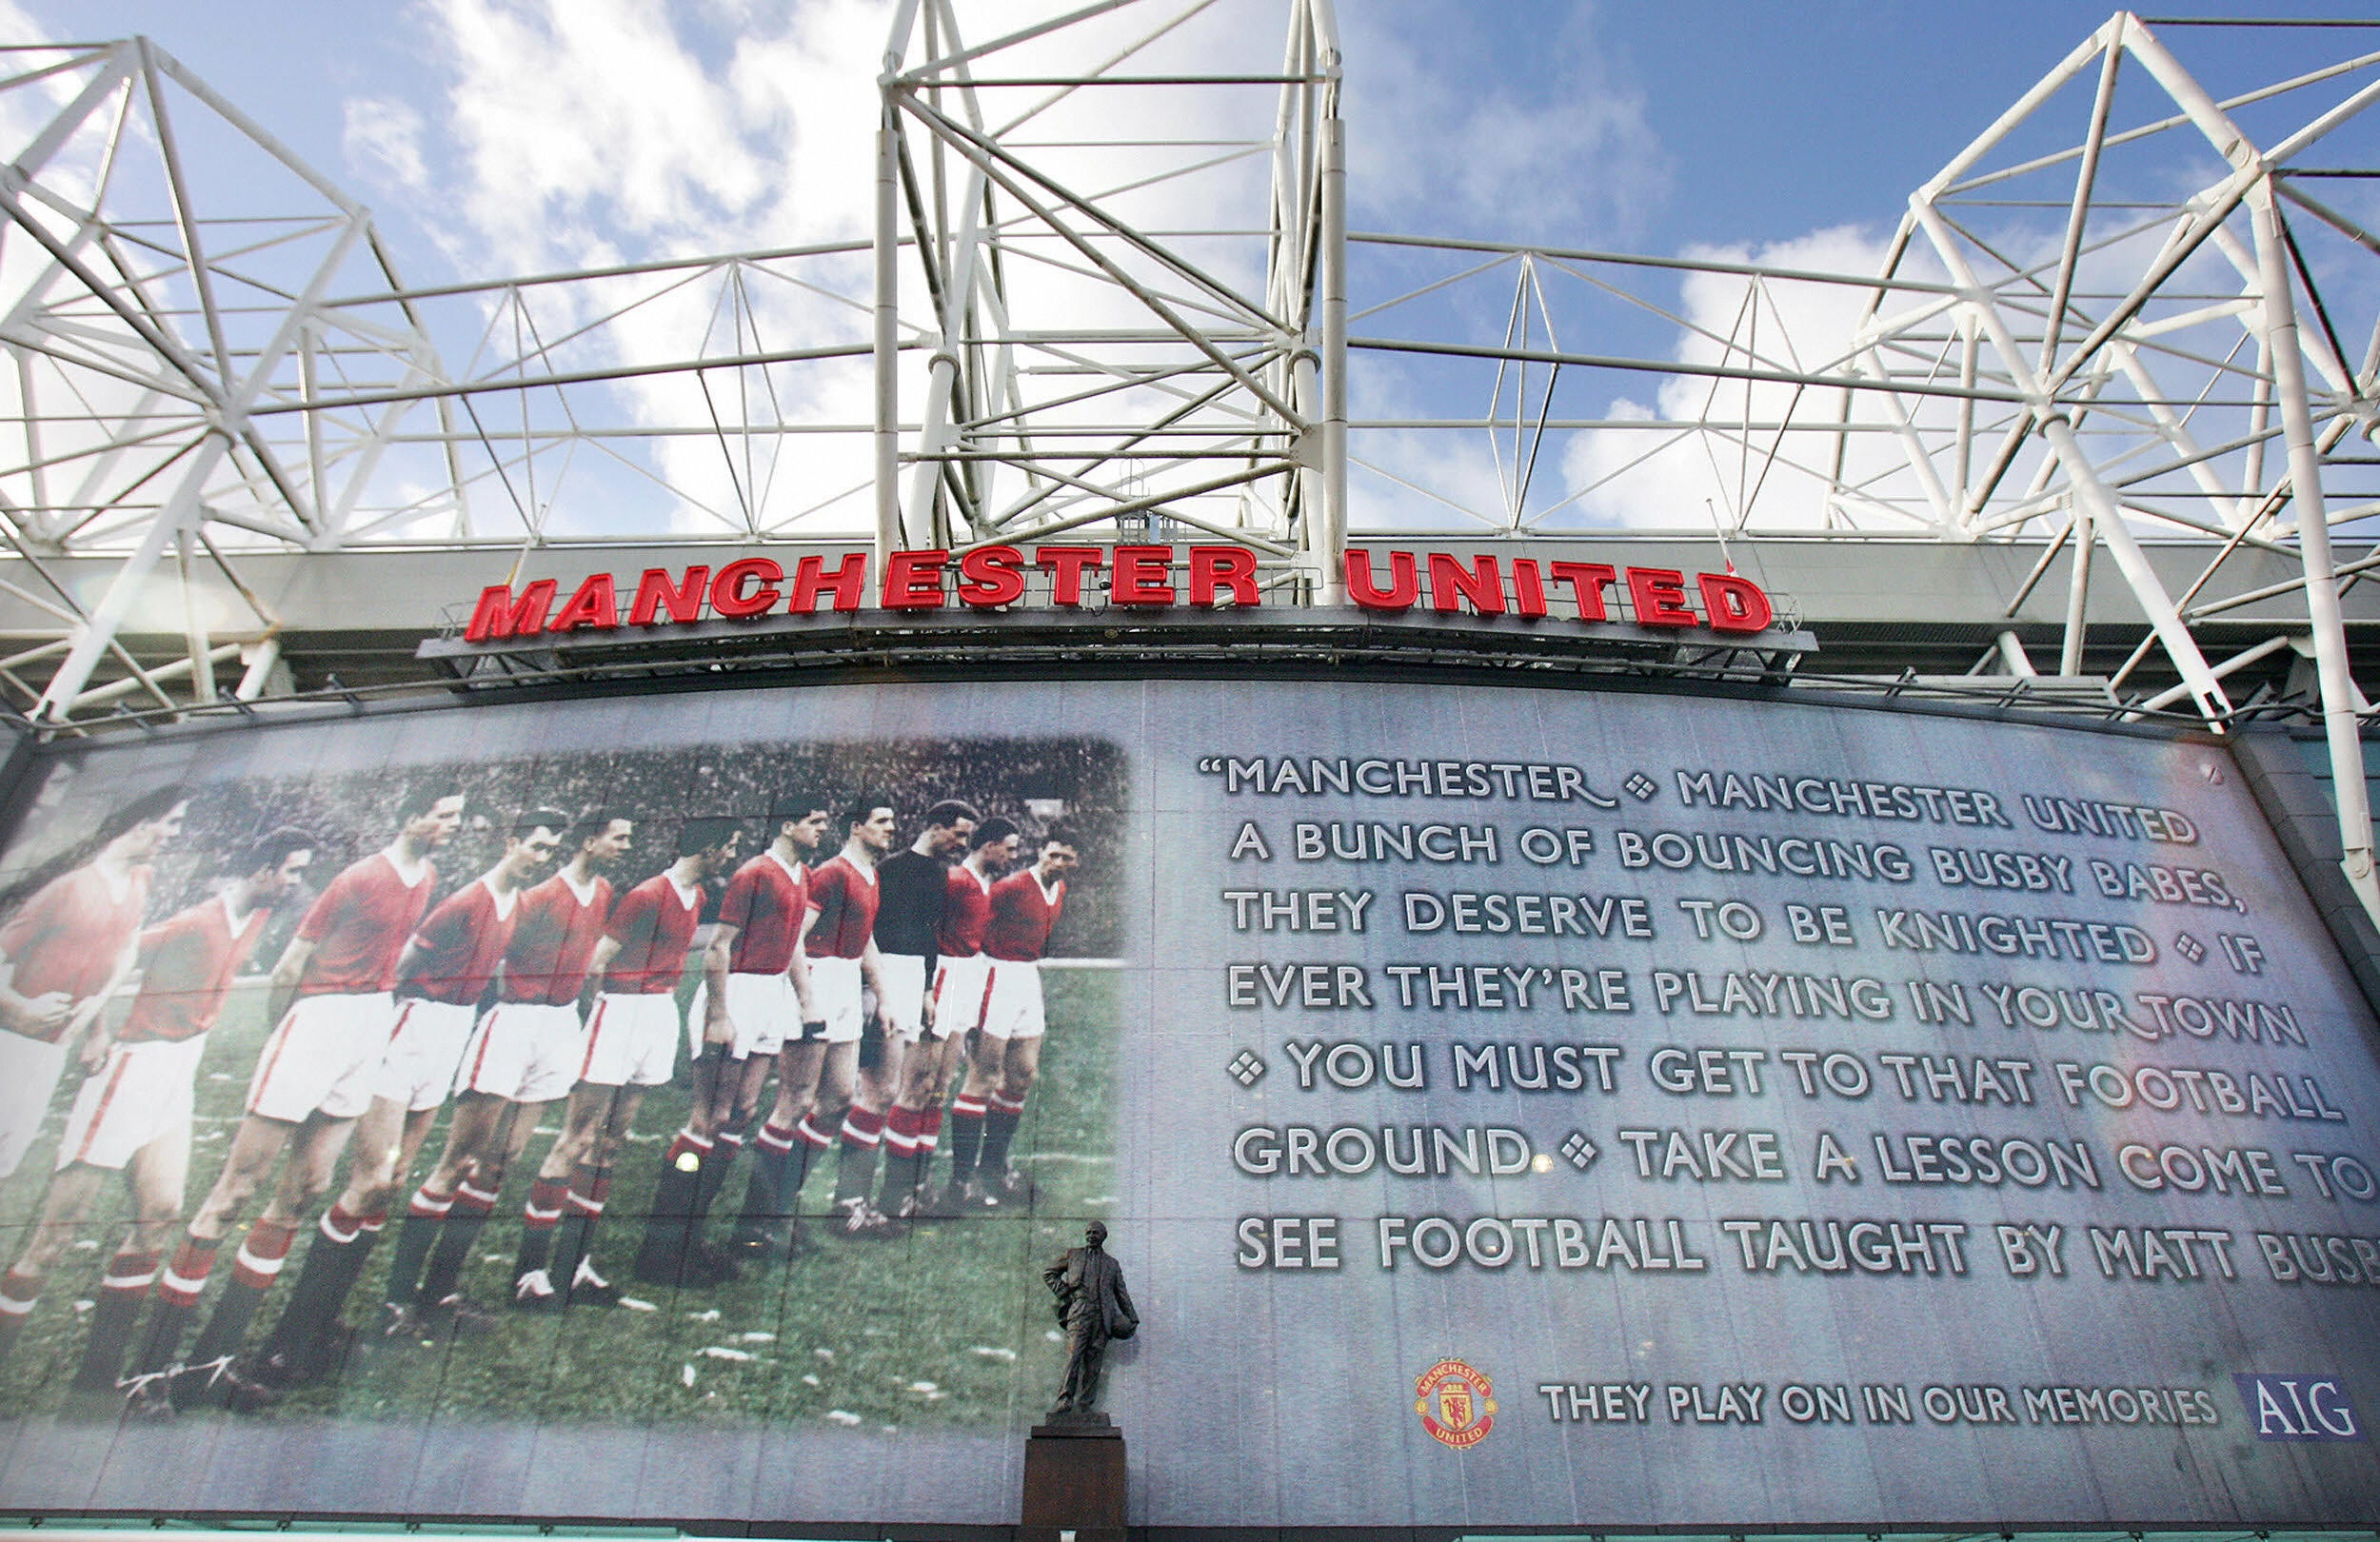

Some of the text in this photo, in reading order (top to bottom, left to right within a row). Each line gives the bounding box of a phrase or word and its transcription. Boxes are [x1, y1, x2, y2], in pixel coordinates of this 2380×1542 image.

[464, 544, 1773, 642] MANCHESTER UNITED
[1676, 771, 2008, 826] MANCHESTER
[2023, 796, 2195, 843] UNITED
[1231, 822, 1269, 860] A
[1298, 822, 1497, 861] BUNCH
[1519, 828, 1592, 866] OF
[1618, 832, 1911, 880] BOUNCING
[2092, 861, 2246, 914] BABES,
[1224, 891, 2264, 973] THEY DESERVE TO BE KNIGHTED IF
[1228, 964, 2308, 1046] EVER THEY’RE PLAYING IN YOUR TOWN
[1286, 1042, 2344, 1120] YOU MUST GET TO THAT FOOTBALL
[1234, 1127, 2376, 1199] GROUND TAKE A LESSON COME TO
[1239, 1217, 2380, 1285] SEE FOOTBALL TAUGHT BY MATT BUSB
[1421, 1364, 1487, 1393] MANCHESTER
[1540, 1385, 2218, 1424] THEY PLAY ON IN OUR MEMORIES
[2256, 1378, 2357, 1436] AIG
[1436, 1428, 1483, 1443] UNITED
